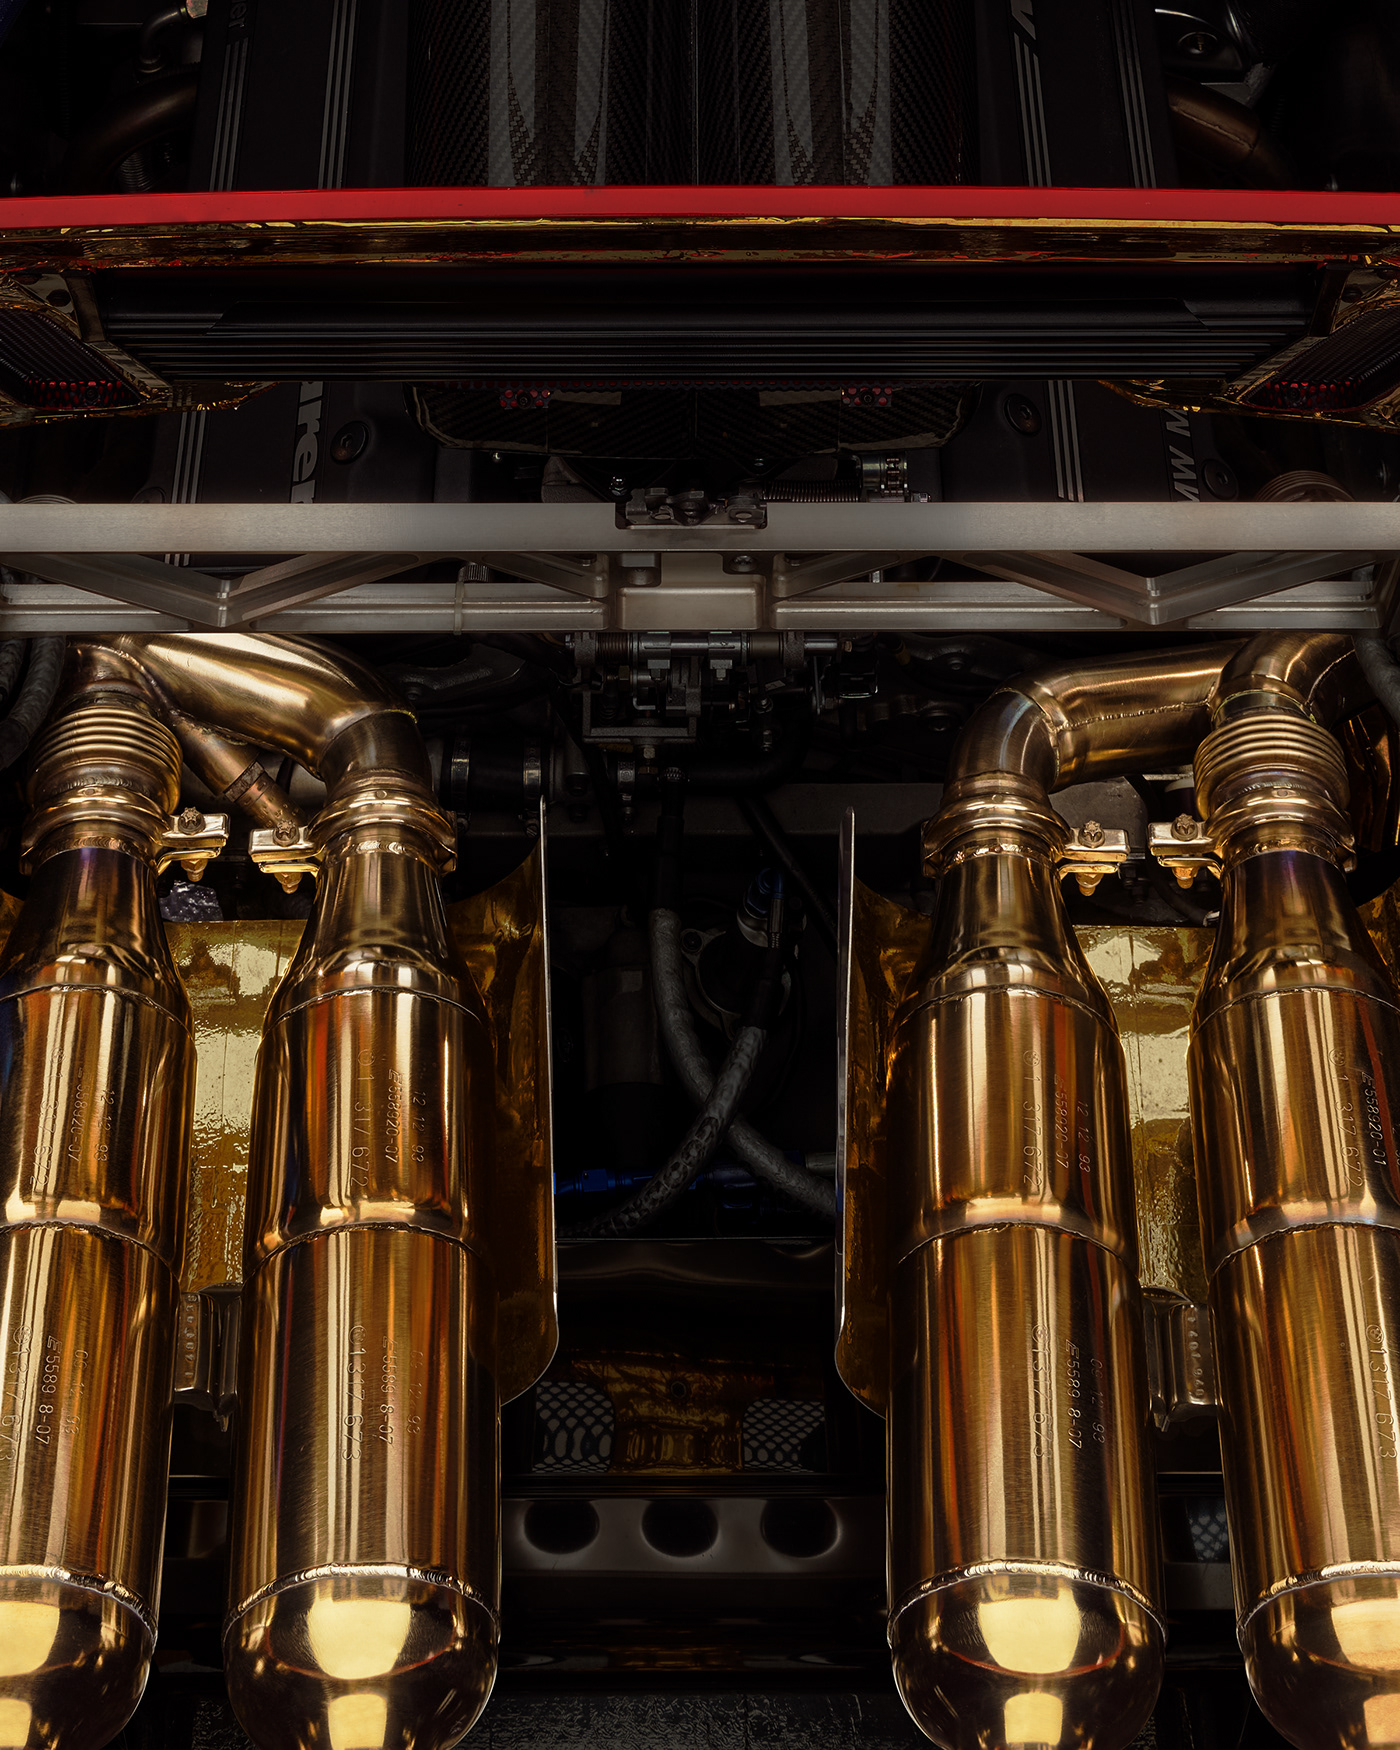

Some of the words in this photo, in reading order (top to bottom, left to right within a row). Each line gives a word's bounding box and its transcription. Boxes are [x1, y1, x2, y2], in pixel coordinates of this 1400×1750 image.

[100, 1089, 116, 1105] 12
[412, 1091, 427, 1107] 12
[1077, 1101, 1090, 1118] 12
[98, 1116, 112, 1131] 12
[353, 1101, 372, 1136] 317
[412, 1116, 426, 1132] 12
[1022, 1101, 1042, 1137] 317
[1334, 1101, 1358, 1137] 317
[1077, 1126, 1091, 1144] 12
[29, 1145, 54, 1186] 672
[94, 1143, 109, 1162] 93
[411, 1144, 425, 1163] 93
[1023, 1145, 1043, 1187] 672
[1078, 1153, 1092, 1173] 93
[350, 1146, 371, 1188] 672
[35, 1404, 55, 1445] 8-07
[64, 1415, 81, 1435] 93
[342, 1414, 364, 1461] 673
[379, 1404, 395, 1446] 8-07
[406, 1415, 422, 1435] 93
[1032, 1412, 1054, 1459] 673
[1067, 1407, 1083, 1450] 8-07
[1092, 1422, 1106, 1444] 93
[1374, 1412, 1398, 1459] 673
